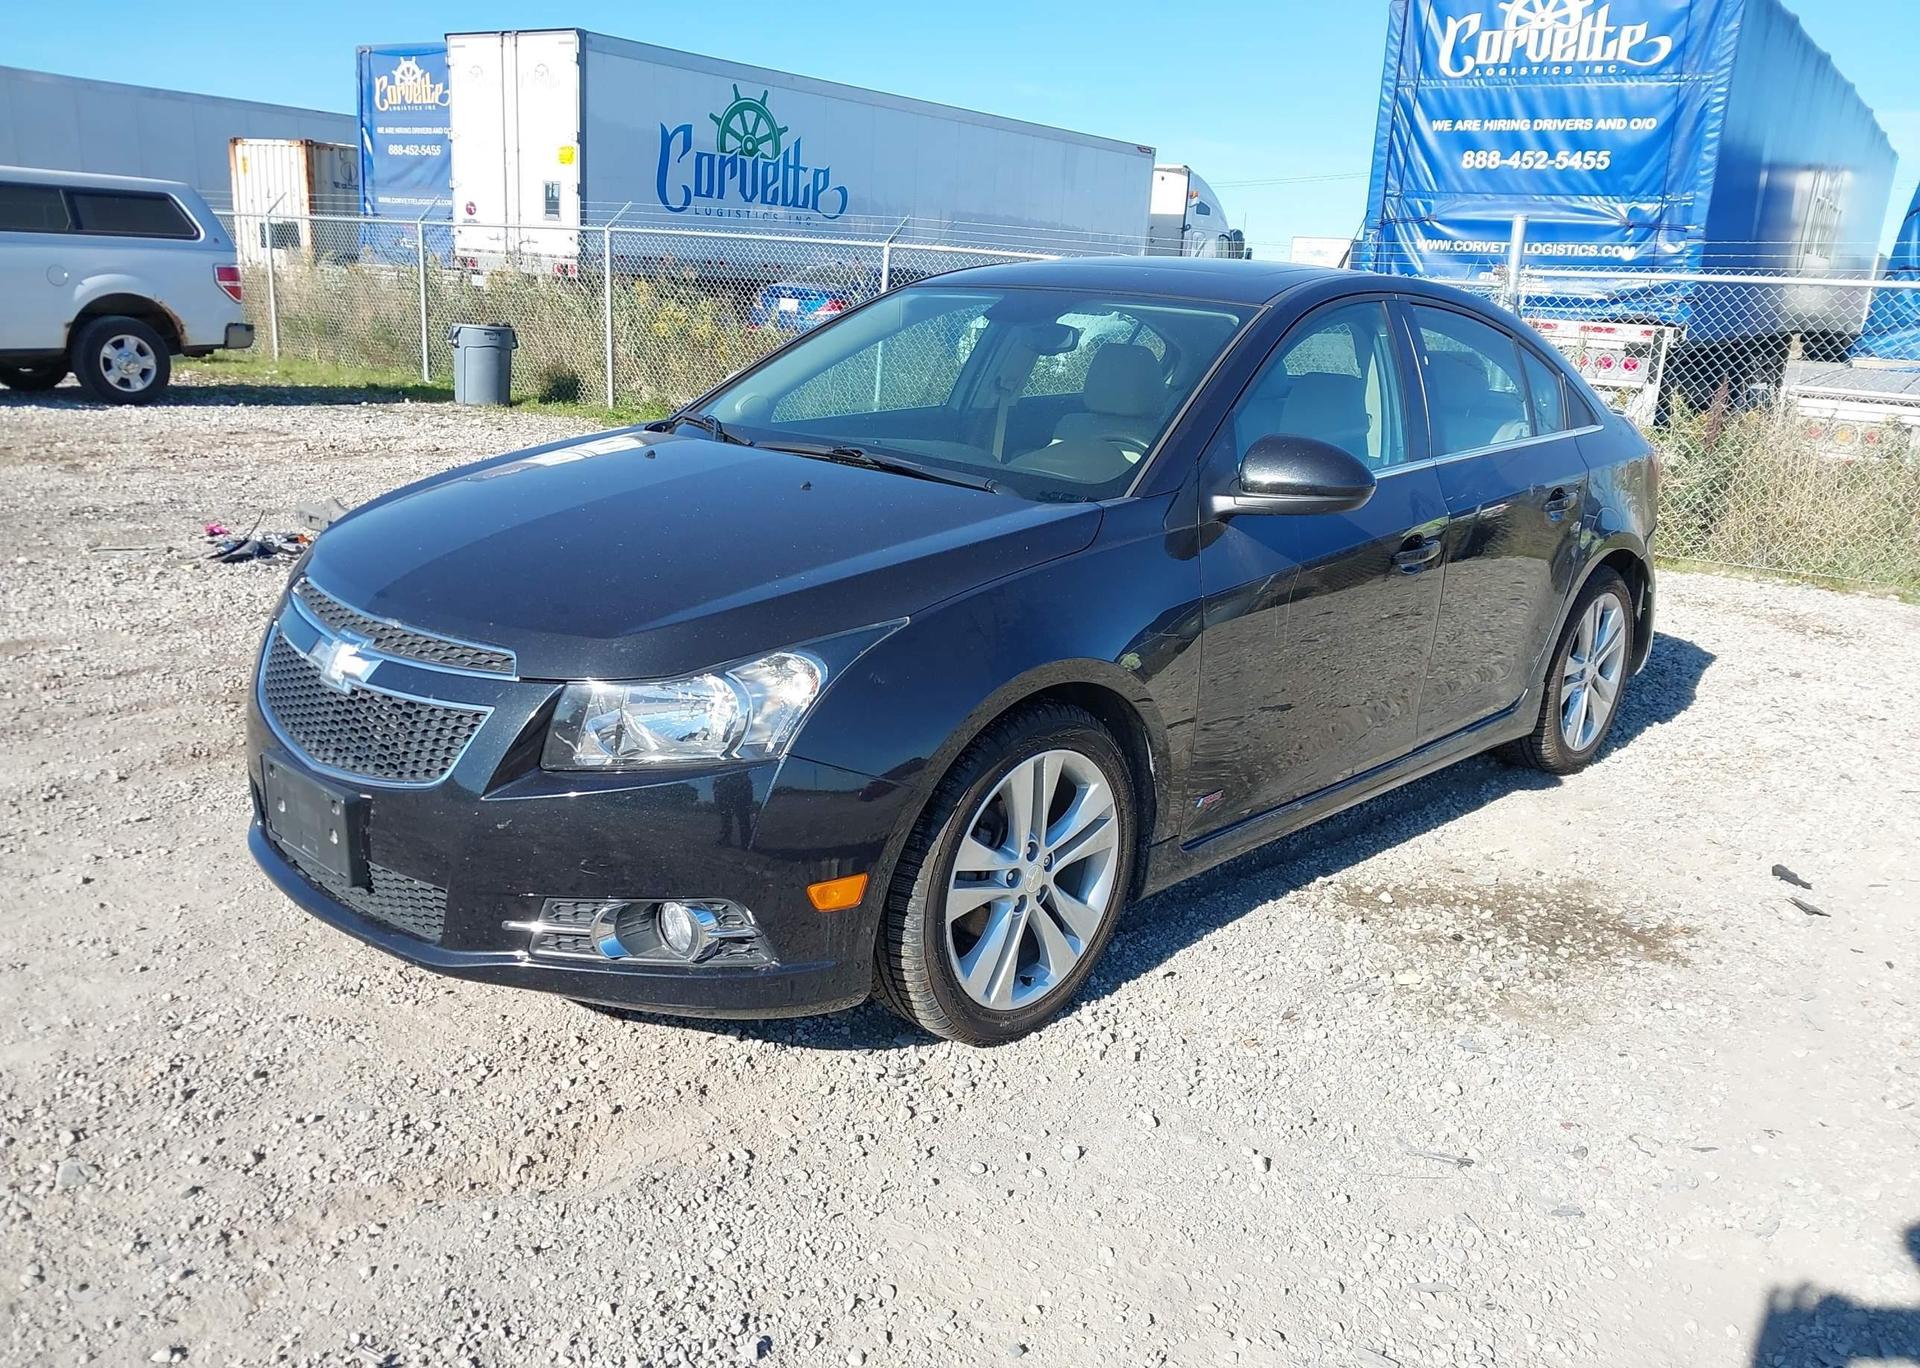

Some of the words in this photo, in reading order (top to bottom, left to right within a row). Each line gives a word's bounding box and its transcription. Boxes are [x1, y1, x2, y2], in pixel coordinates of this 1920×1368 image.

[1438, 3, 1673, 78] Corvette
[1474, 65, 1574, 77] LOGISTICS
[1585, 64, 1627, 75] INC.
[374, 72, 451, 112] Corvette
[1431, 119, 1453, 132] WE
[1454, 119, 1481, 132] ARE
[1483, 118, 1531, 132] HIRING
[1533, 118, 1594, 132] DRIVERS
[1595, 117, 1628, 131] AND
[1629, 117, 1658, 131] O/O
[388, 144, 442, 156] 888-452-5455
[1461, 149, 1612, 171] 888-452-5455
[656, 121, 849, 220] Corvette
[693, 204, 779, 223] LOGISTICS
[788, 215, 819, 226] INC.
[1415, 238, 1637, 260] WWW.CORVETLOGISTICS.COM
